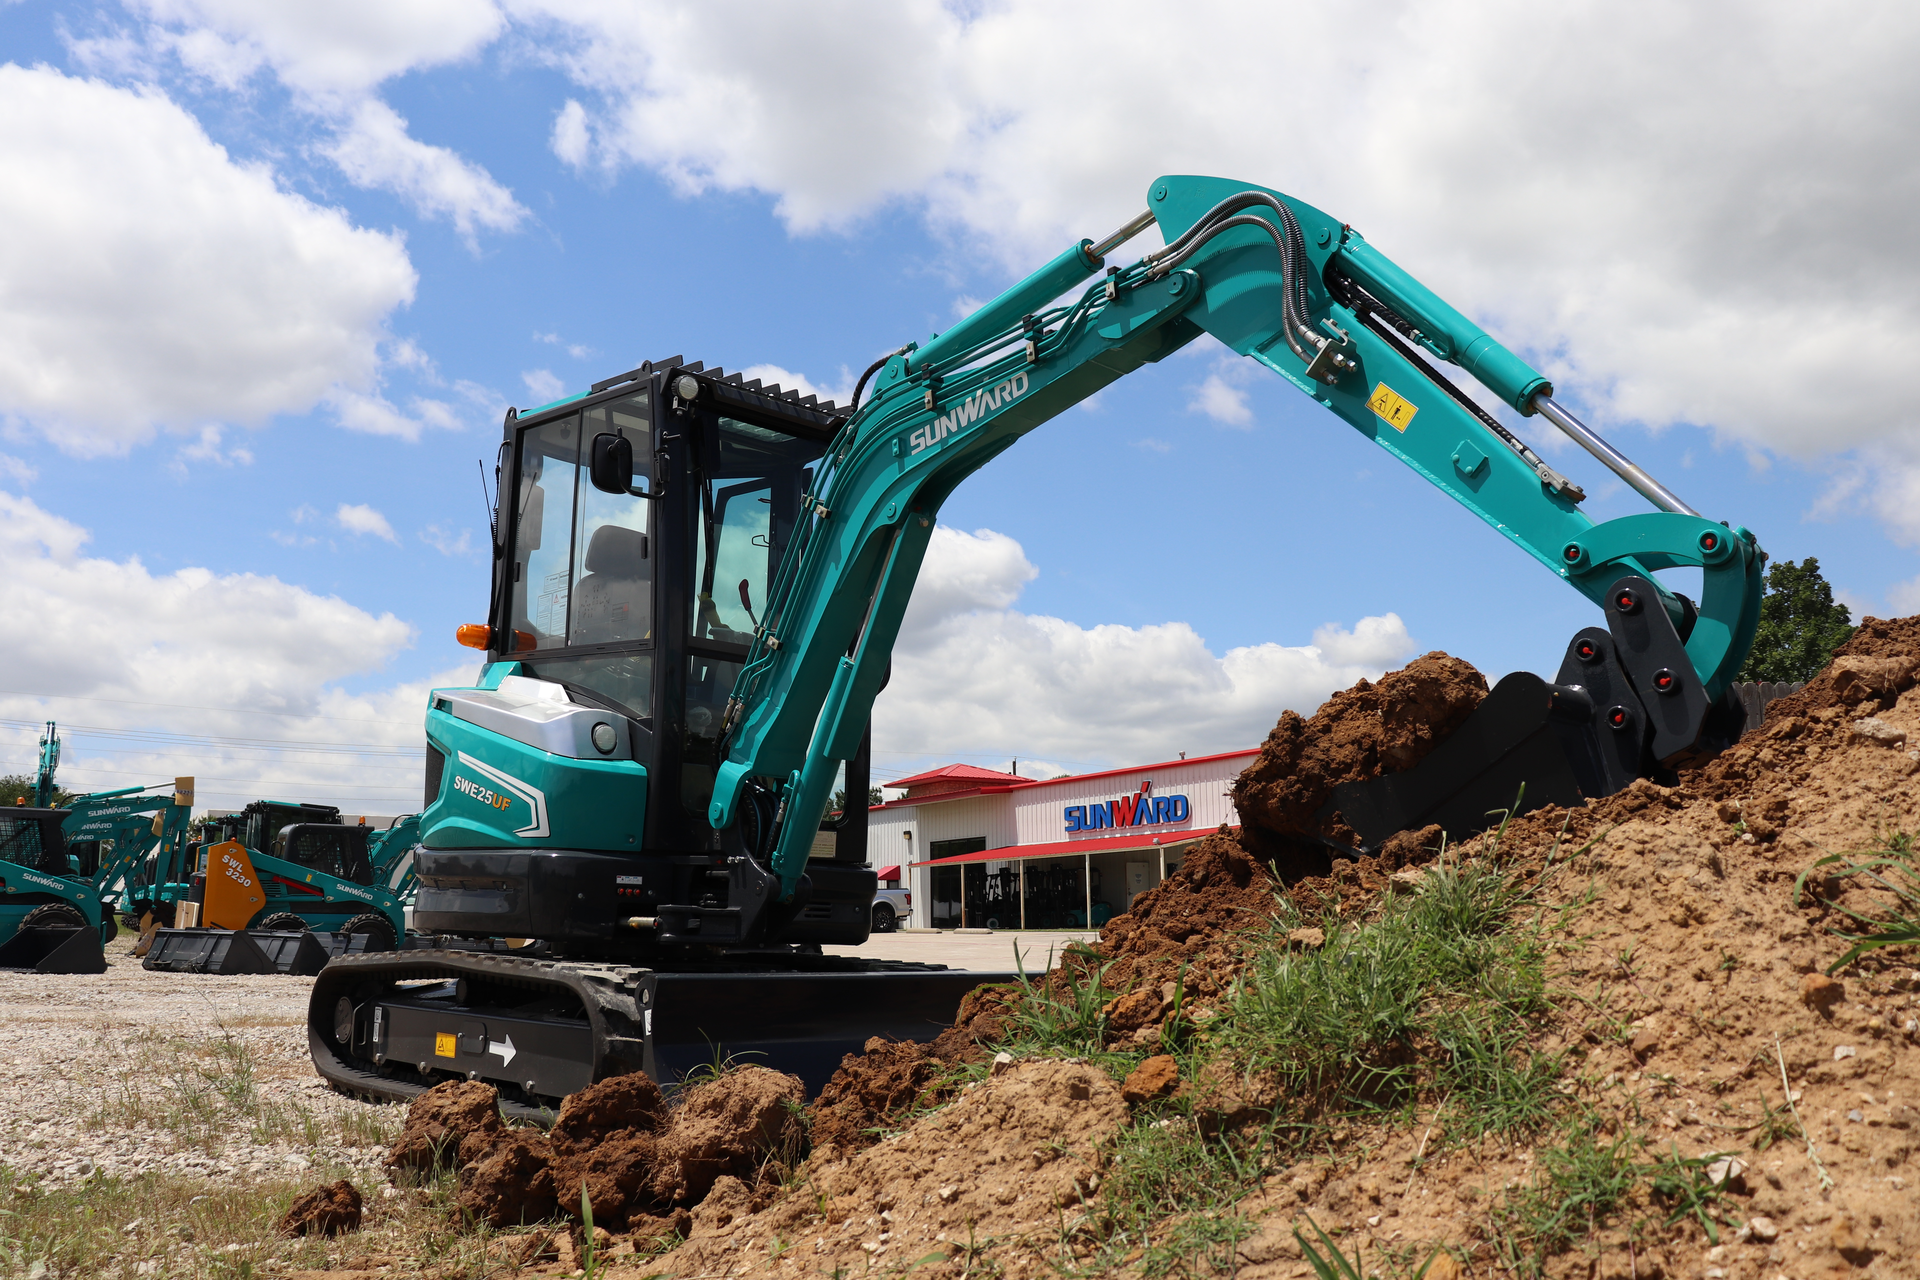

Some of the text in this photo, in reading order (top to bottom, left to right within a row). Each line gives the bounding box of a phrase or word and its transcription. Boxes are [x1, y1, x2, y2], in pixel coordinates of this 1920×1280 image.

[909, 371, 1029, 456] SUNWARD
[453, 775, 511, 811] SWE25UF
[87, 805, 131, 817] SUNWARD
[1064, 779, 1190, 833] SUNWARD
[81, 821, 112, 830] NWARD
[221, 854, 244, 873] SWL
[22, 872, 64, 891] SUNWARD
[225, 868, 252, 888] 3230
[336, 883, 374, 901] SUNWARD
